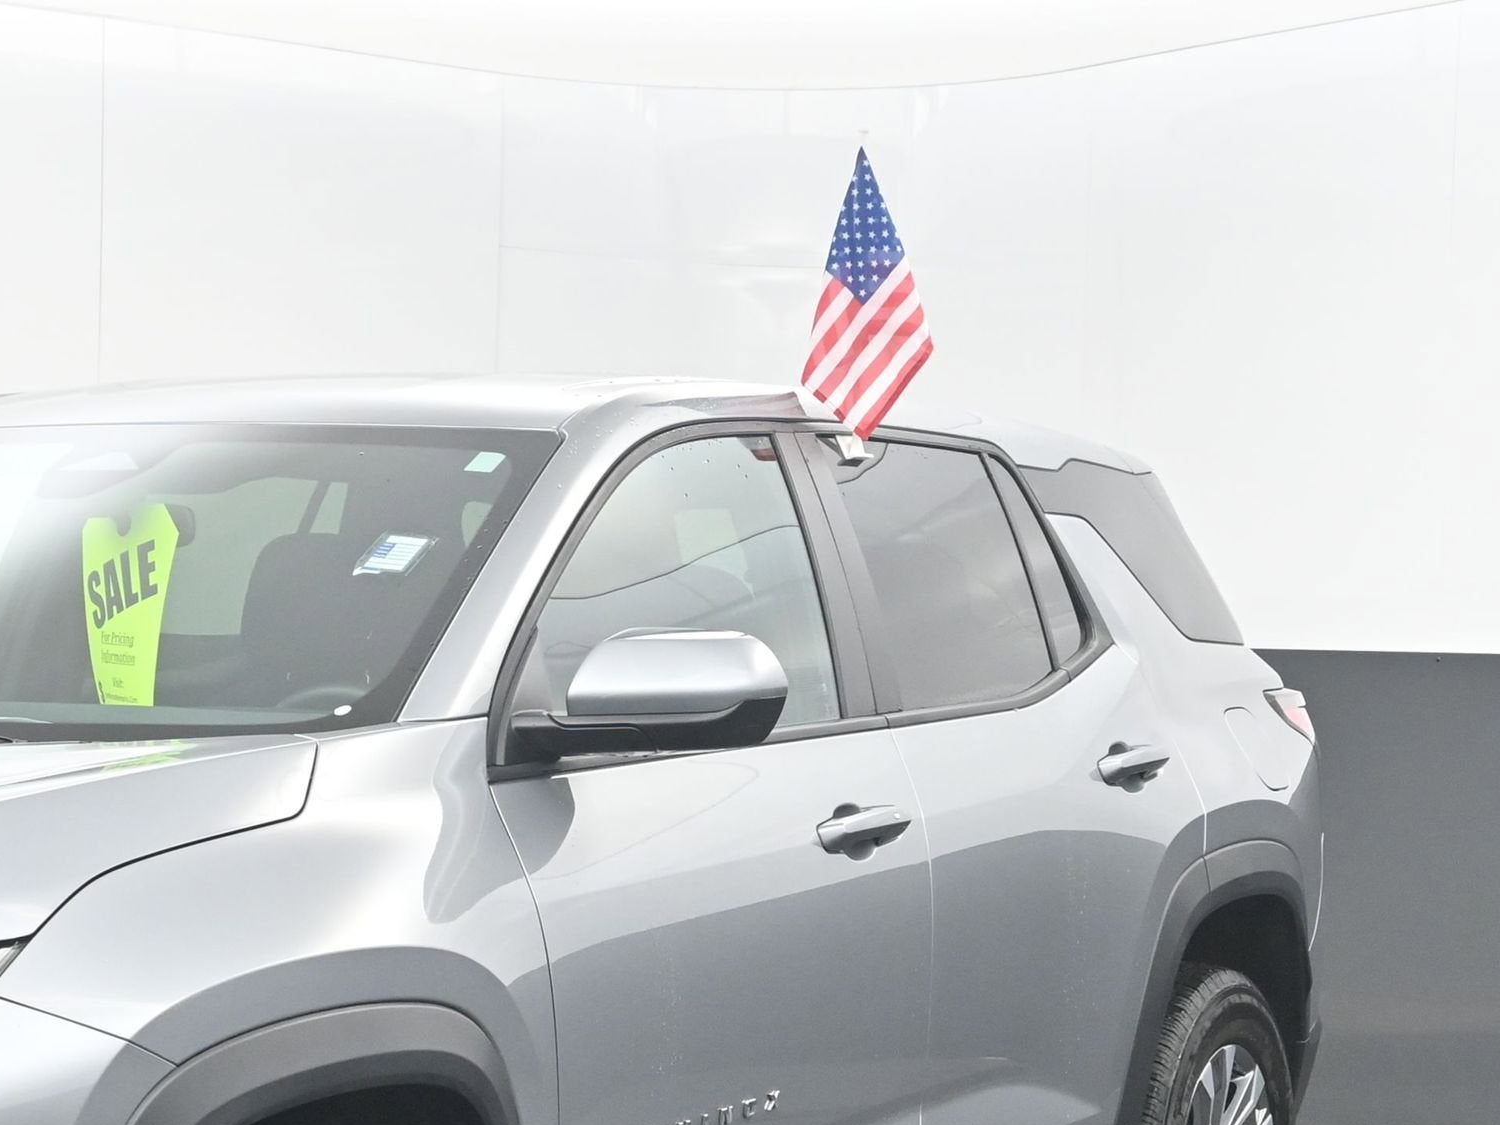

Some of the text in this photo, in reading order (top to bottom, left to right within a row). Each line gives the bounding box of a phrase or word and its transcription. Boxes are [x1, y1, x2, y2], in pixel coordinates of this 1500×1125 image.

[87, 538, 158, 630] SALE
[101, 630, 135, 648] For Pricing
[101, 648, 135, 665] Information
